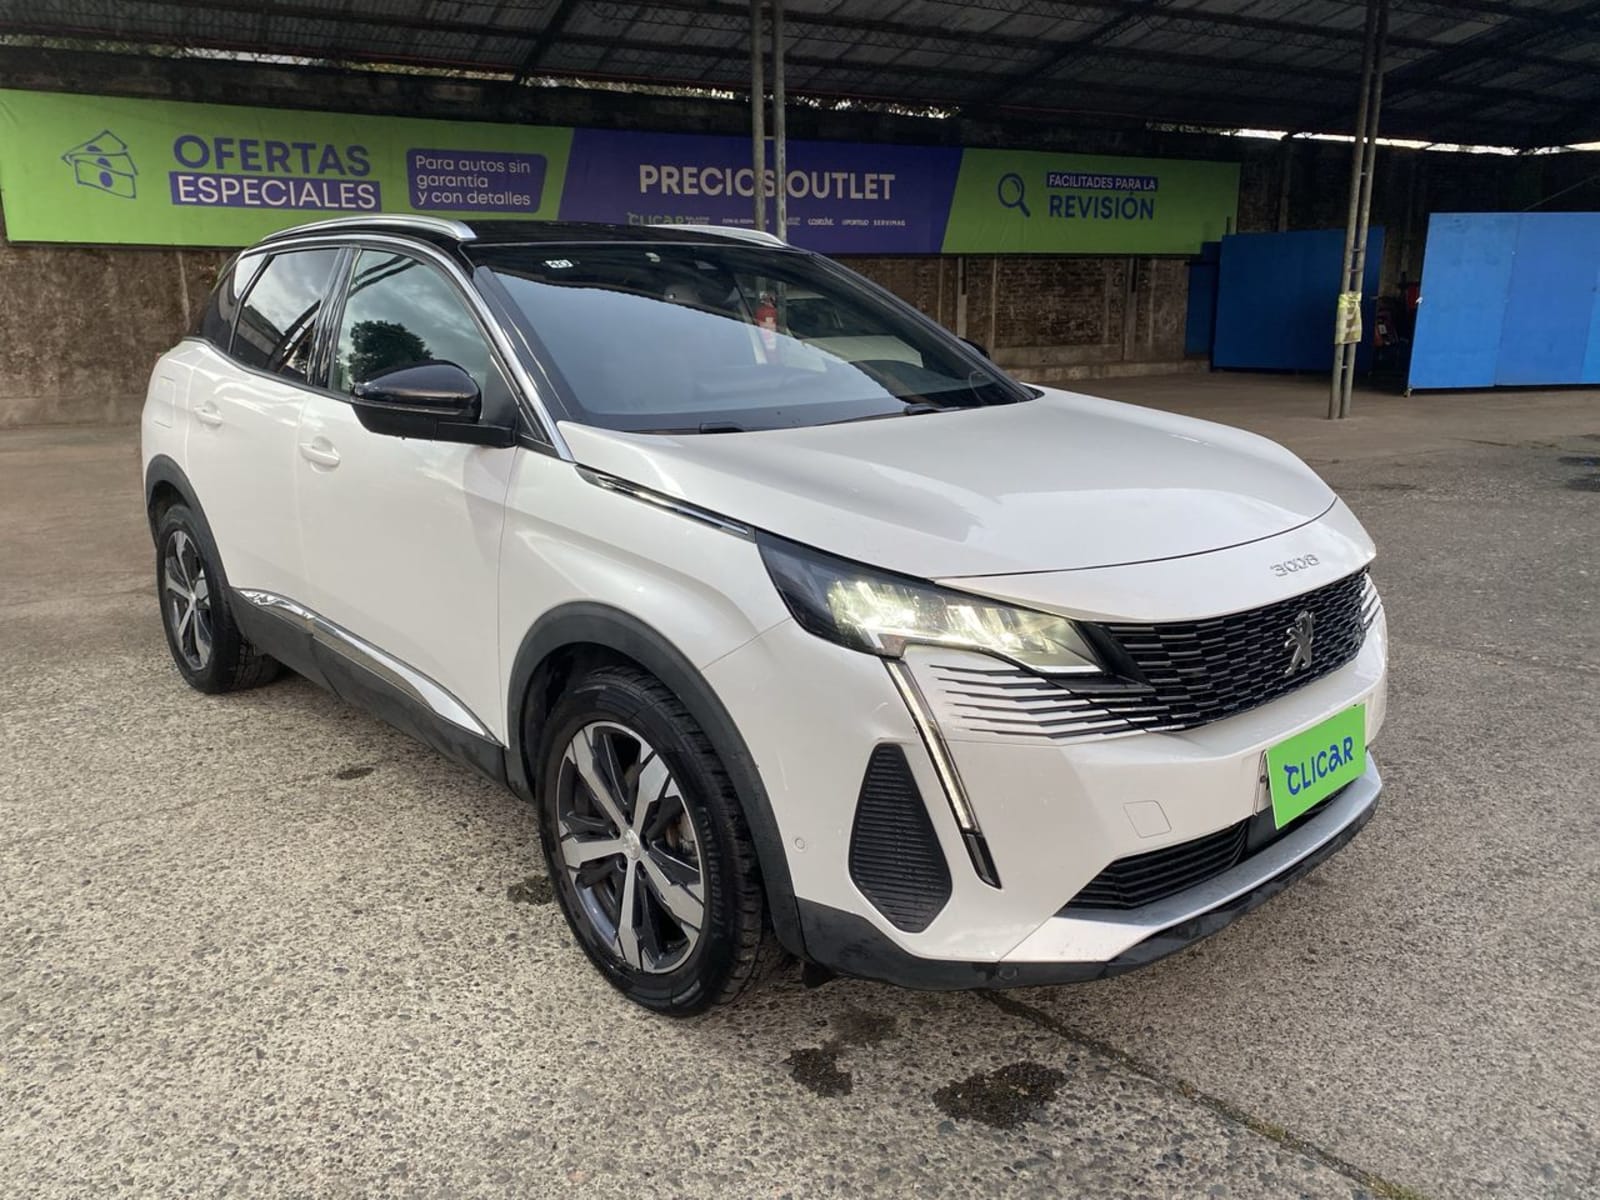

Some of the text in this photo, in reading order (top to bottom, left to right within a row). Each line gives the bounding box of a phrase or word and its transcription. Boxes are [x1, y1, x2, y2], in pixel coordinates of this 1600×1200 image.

[173, 135, 371, 177] OFERTAS
[415, 155, 531, 174] Para autos sin
[177, 176, 377, 210] ESPECIALES
[786, 170, 896, 200] OUTLET
[1115, 178, 1141, 190] PARA
[1143, 180, 1155, 190] LA
[417, 191, 531, 206] y con detalles
[1049, 192, 1155, 220] REVISIÓN
